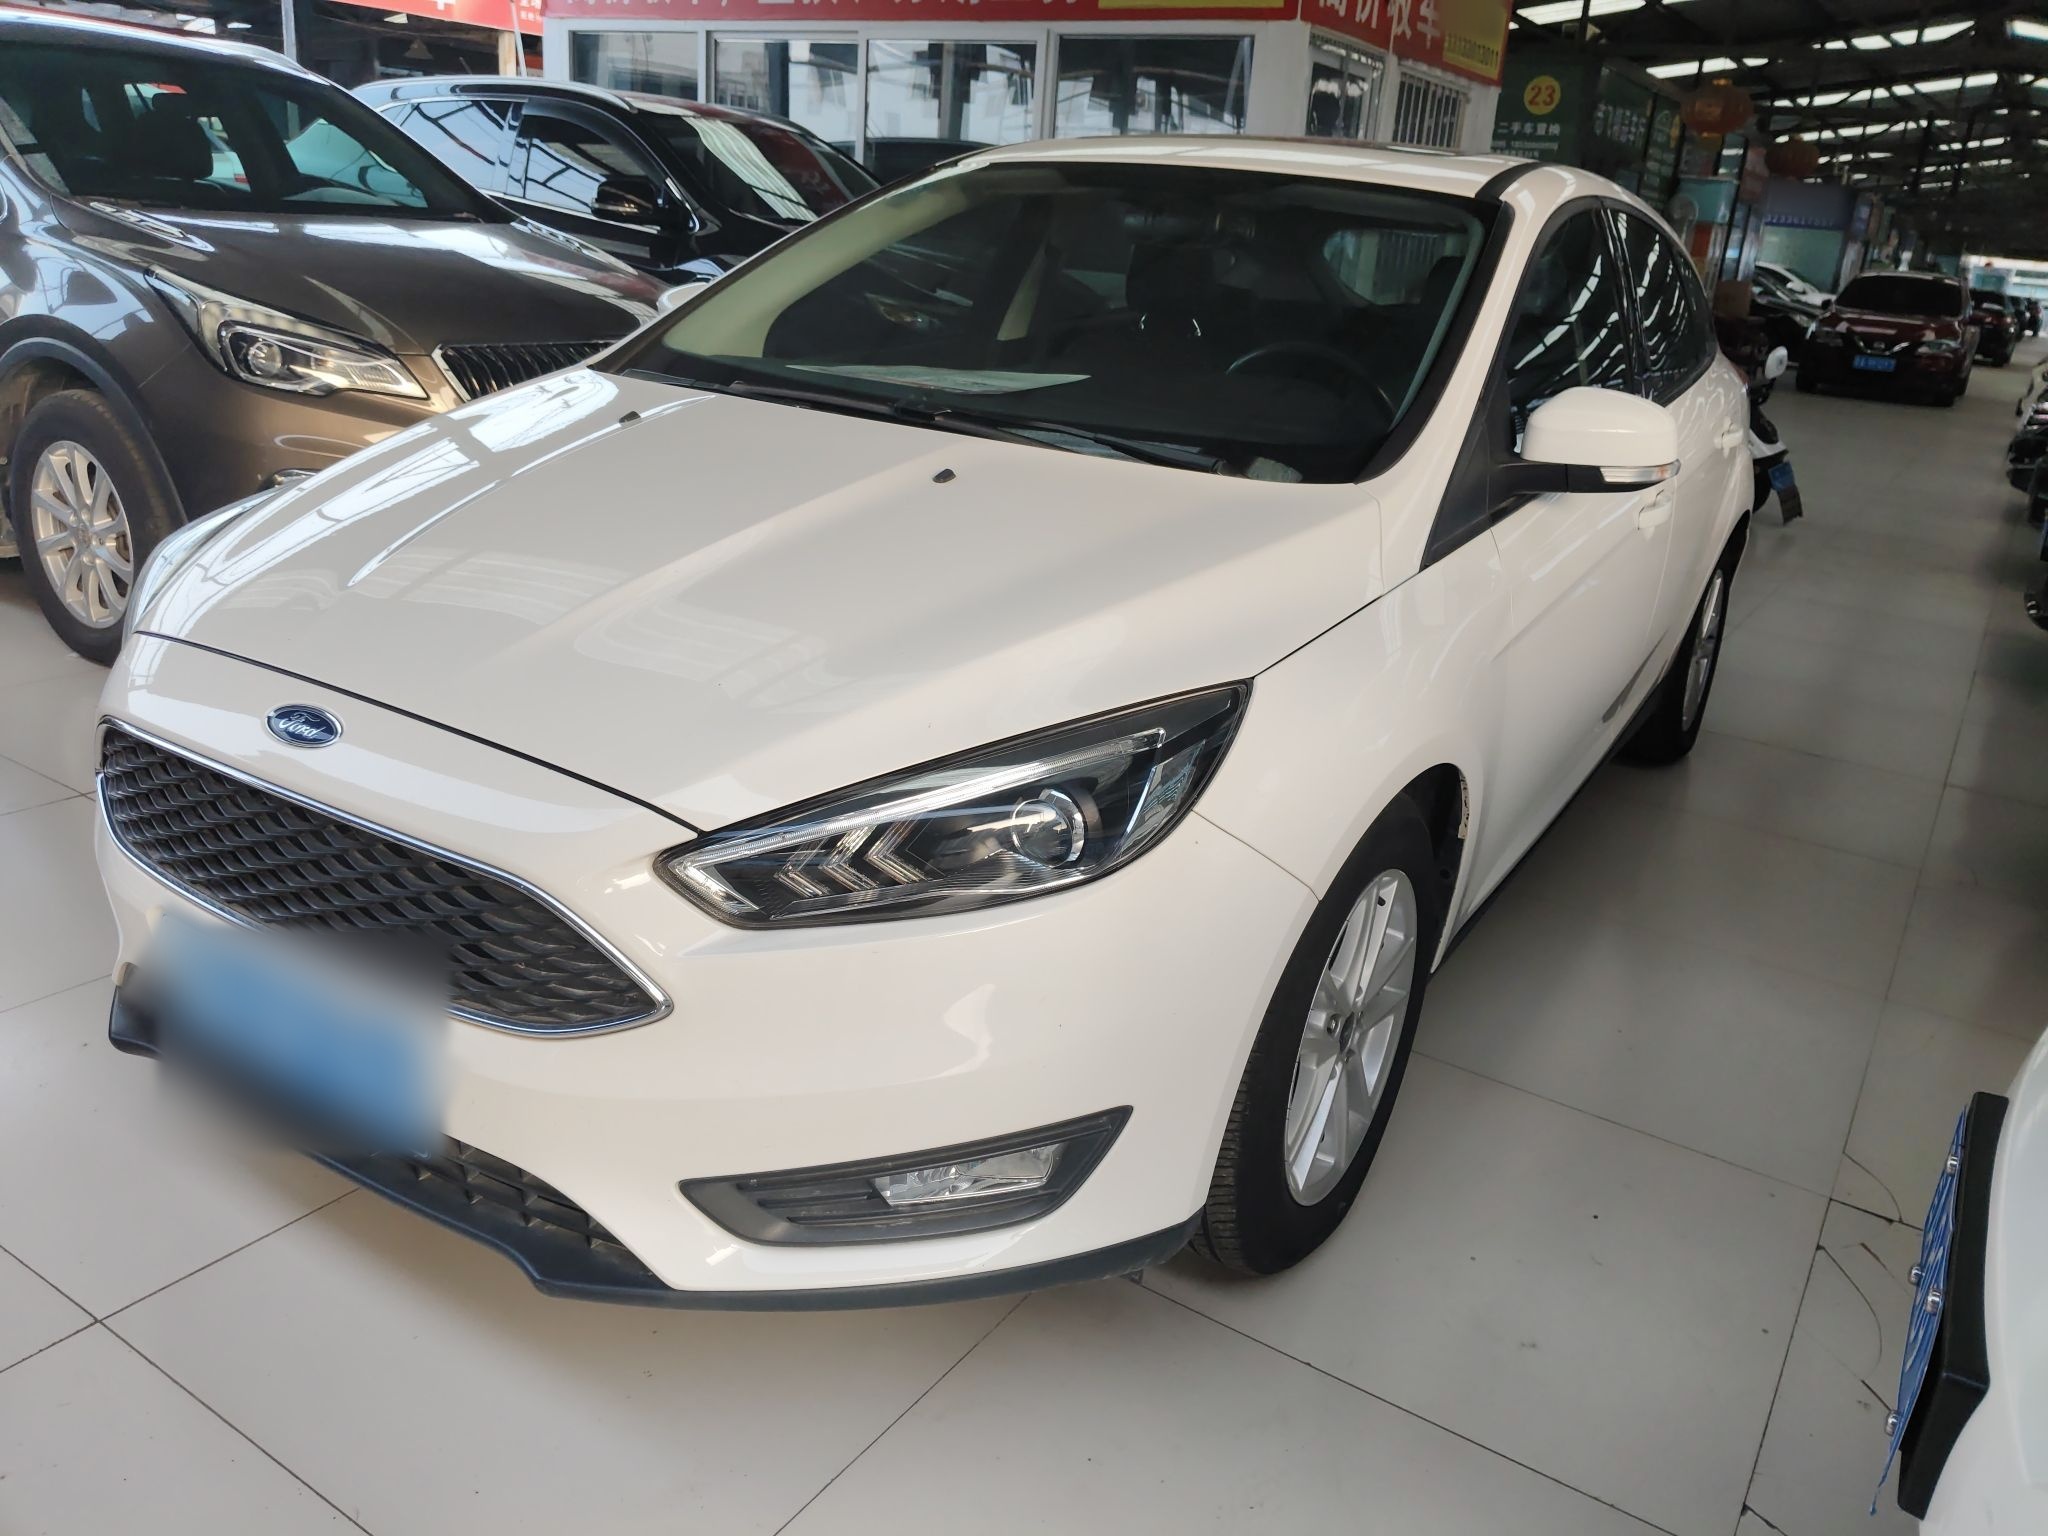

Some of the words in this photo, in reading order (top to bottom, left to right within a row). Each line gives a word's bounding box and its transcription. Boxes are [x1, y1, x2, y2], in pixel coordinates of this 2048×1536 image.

[1318, 0, 1441, 49] 收车
[1528, 84, 1556, 106] 23
[278, 711, 327, 739] Ford
